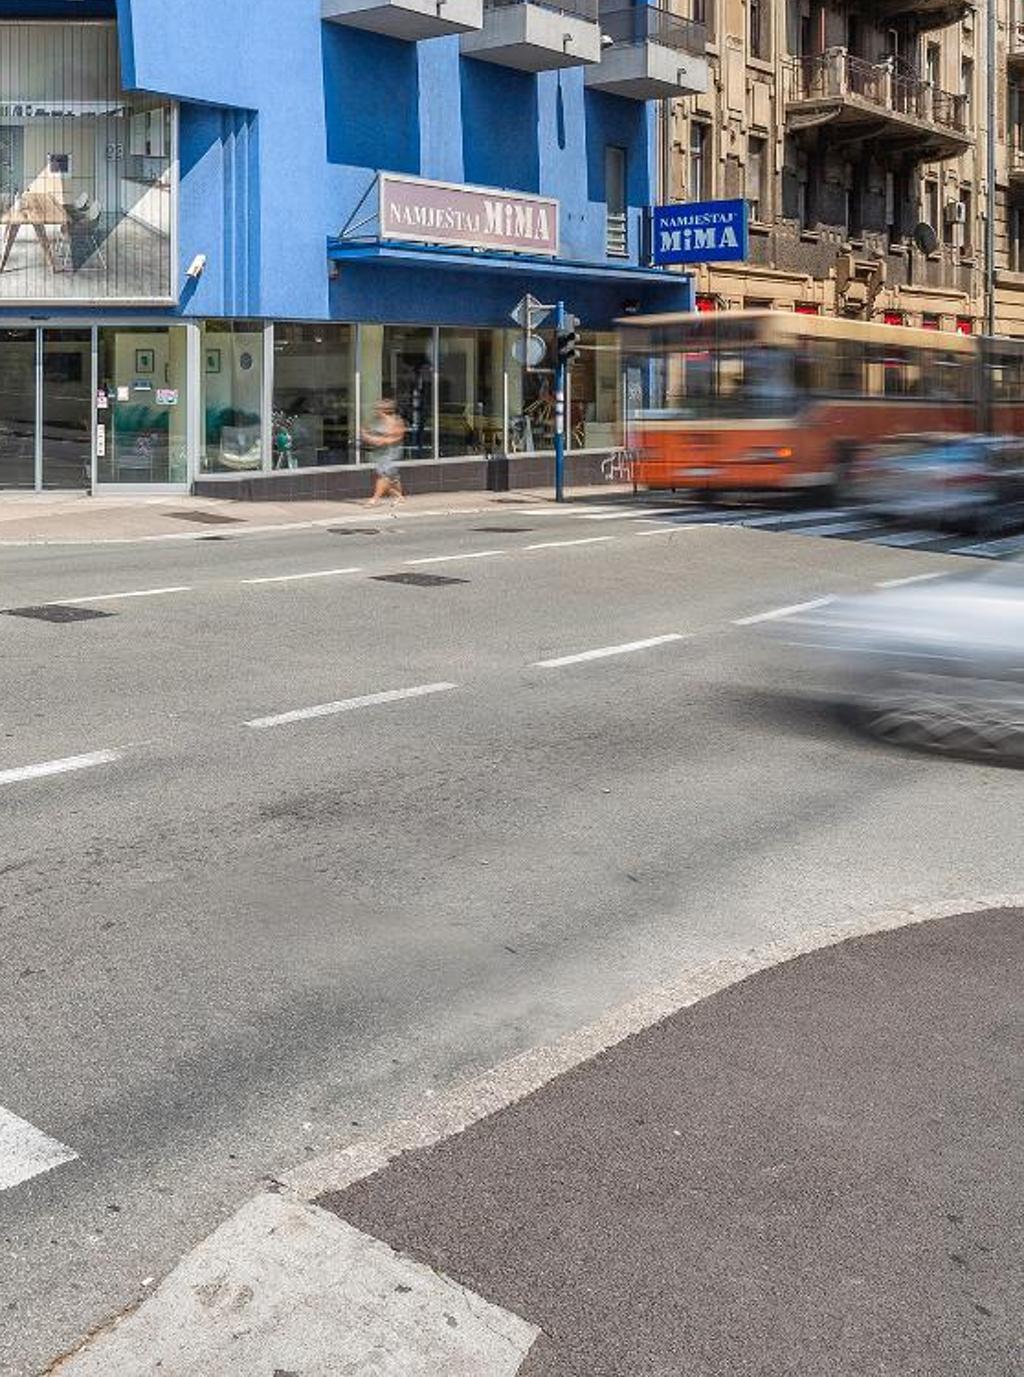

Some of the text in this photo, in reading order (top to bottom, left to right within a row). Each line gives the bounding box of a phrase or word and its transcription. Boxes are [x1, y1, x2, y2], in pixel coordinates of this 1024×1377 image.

[390, 199, 550, 241] NAMJEŠTAJ MiMA
[659, 212, 734, 228] NAMJEŠTAJ
[659, 226, 739, 252] MiMA
